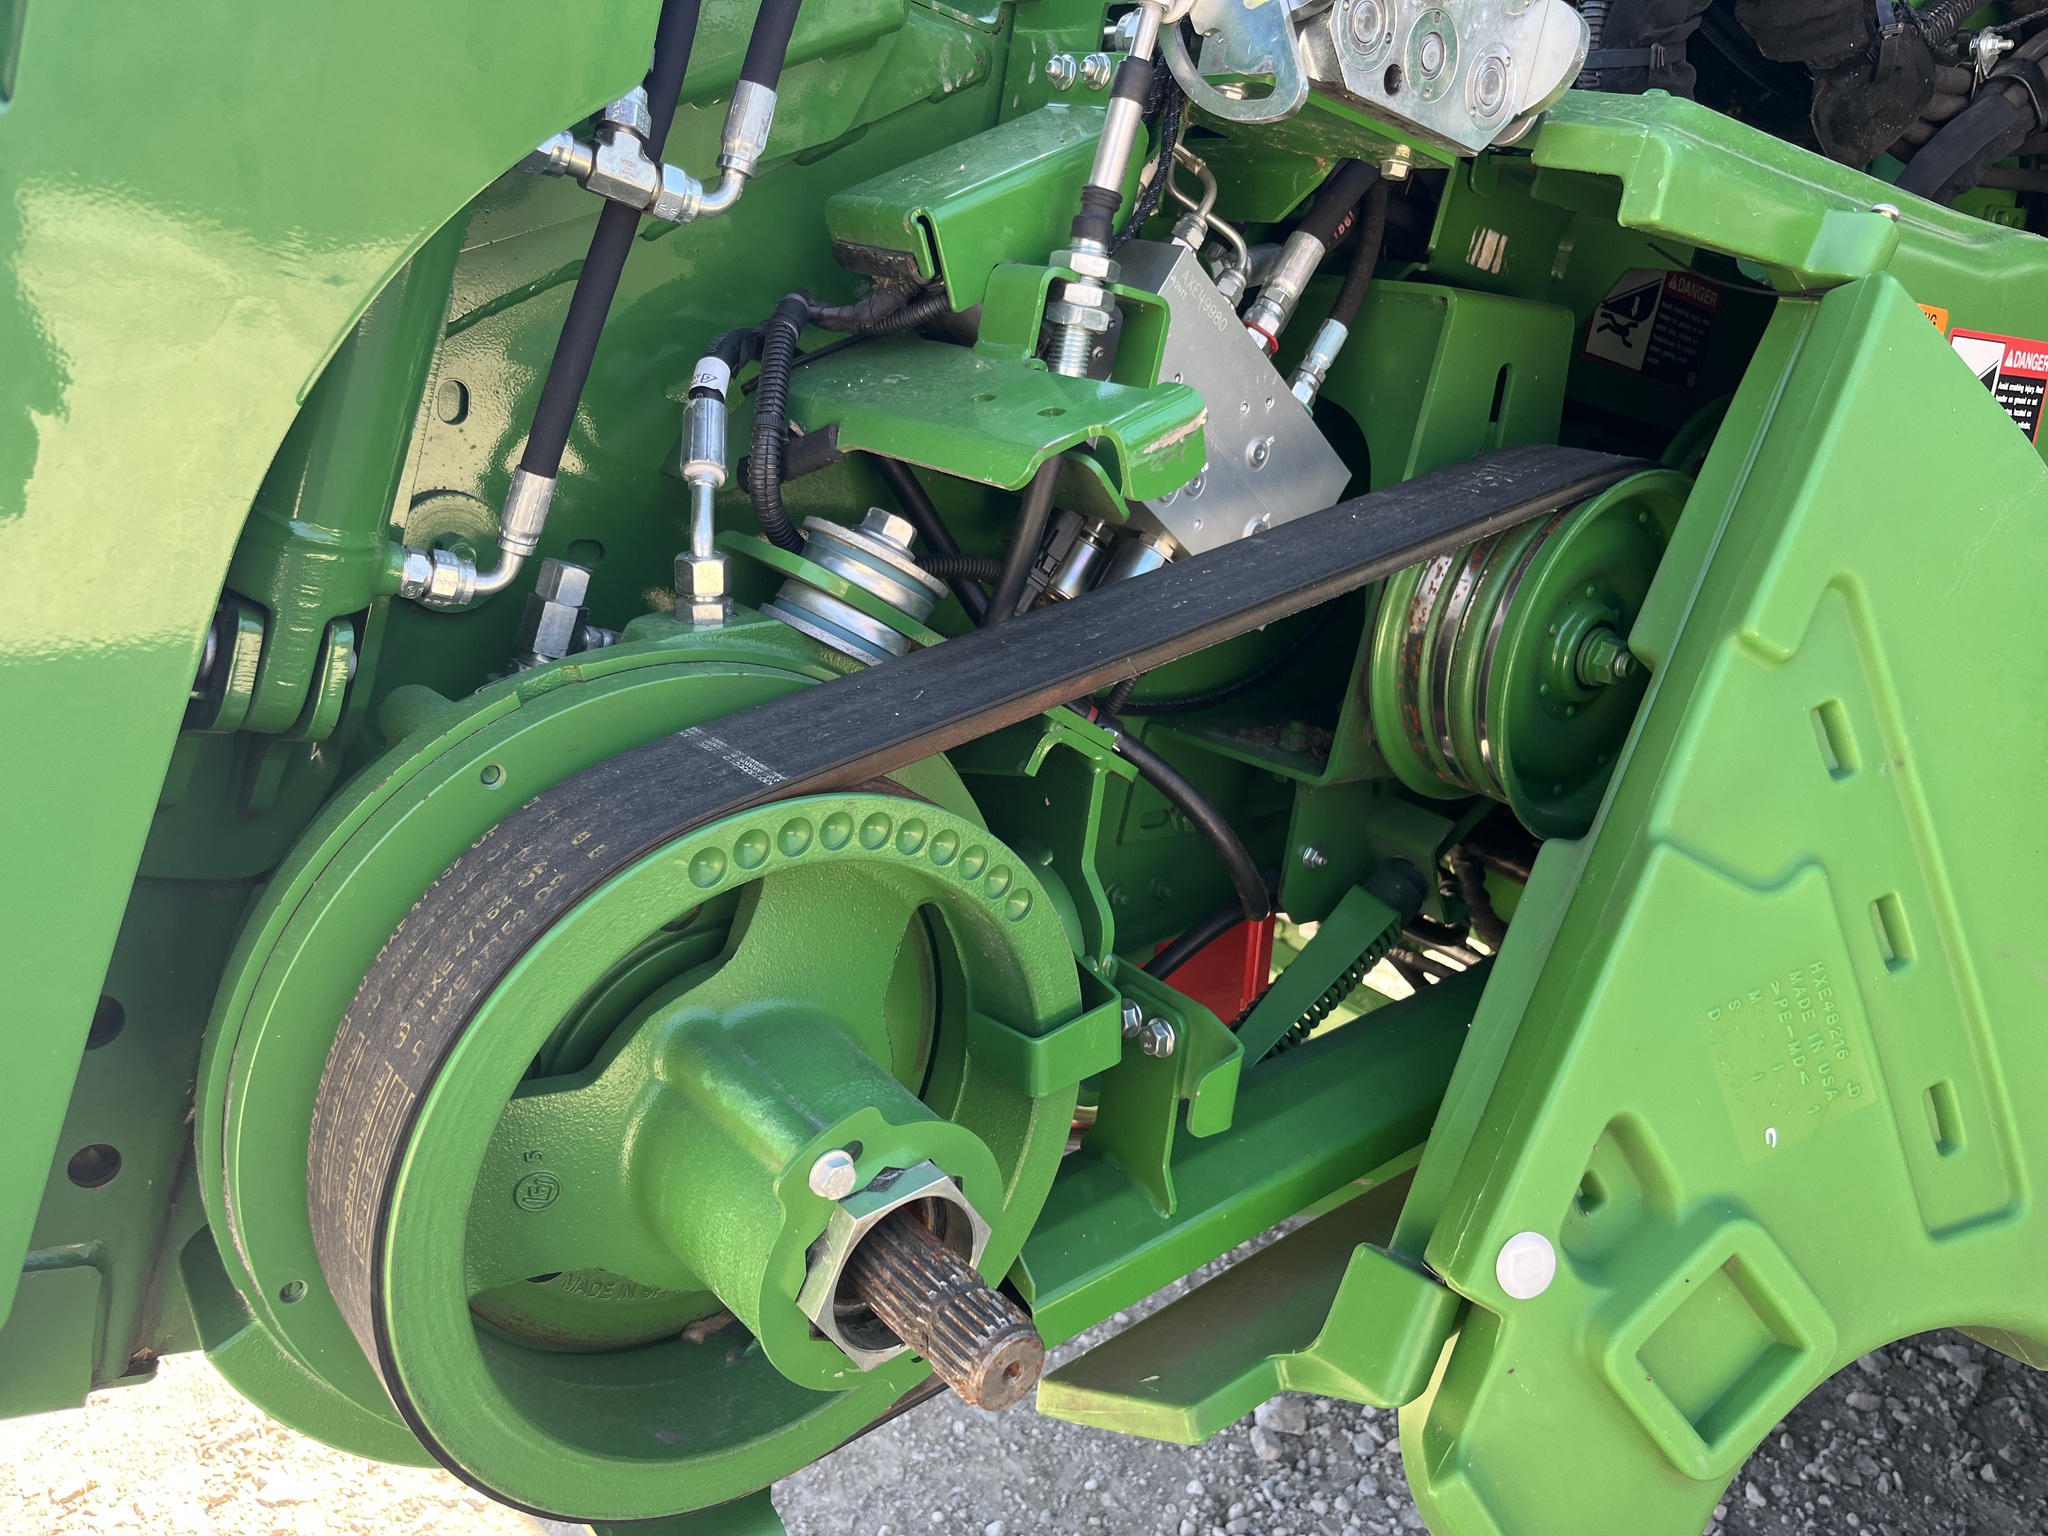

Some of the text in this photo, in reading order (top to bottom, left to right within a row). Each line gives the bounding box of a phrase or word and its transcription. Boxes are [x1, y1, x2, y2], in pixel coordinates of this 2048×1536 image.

[1180, 269, 1228, 331] AXE49980
[1677, 277, 1719, 308] DANGER
[1789, 970, 1838, 1100] MADE IN USA
[1809, 960, 1849, 1060] HXE48216
[561, 1273, 616, 1299] MADE
[617, 1282, 638, 1300] IN
